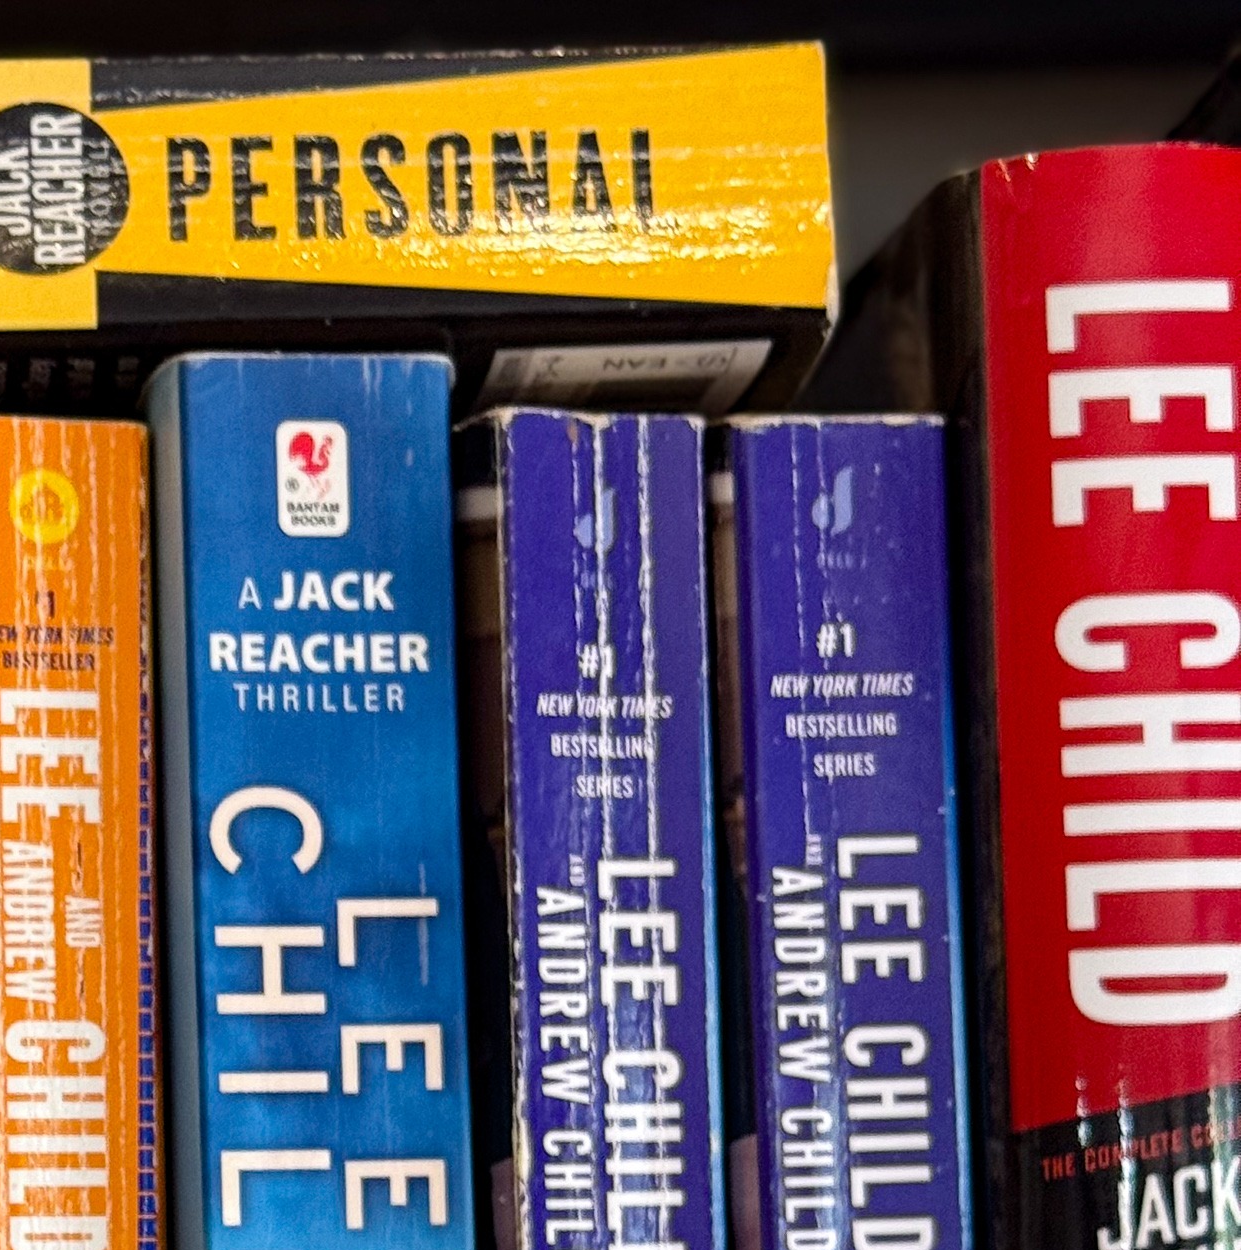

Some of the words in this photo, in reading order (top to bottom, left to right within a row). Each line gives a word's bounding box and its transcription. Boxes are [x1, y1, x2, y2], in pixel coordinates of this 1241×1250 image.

[29, 113, 86, 265] REACHER
[166, 128, 678, 243] PERSONAL
[1045, 279, 1237, 528] LEE
[286, 502, 340, 513] BANTAM
[290, 514, 337, 526] BOOKS
[238, 577, 262, 609] A
[273, 571, 394, 611] JACK
[2, 651, 96, 671] BESTSELLER
[209, 632, 430, 673] REACHER
[816, 623, 855, 658] #1
[233, 682, 405, 712] THRILLER
[537, 693, 573, 717] NEW
[576, 694, 617, 718] YORK
[620, 695, 673, 719] TIMES
[770, 674, 809, 698] NEW
[812, 674, 858, 698] YORK
[861, 672, 914, 697] TIMES
[551, 733, 653, 759] BESTSELLING
[785, 713, 898, 738] BESTSELLING
[0, 688, 101, 824] LEE
[813, 753, 876, 777] SERIES
[576, 775, 633, 799] SERIES
[1054, 589, 1241, 1027] CHILD
[2, 840, 56, 1005] ANDREW
[64, 896, 101, 949] AND
[597, 858, 681, 1007] LEE
[837, 834, 925, 984] LEE
[536, 886, 593, 1103] ANDREW
[771, 866, 831, 1083] ANDREW
[336, 897, 449, 1230] LEE
[1042, 1153, 1076, 1183] THE
[1084, 1127, 1183, 1174] COMPLETE
